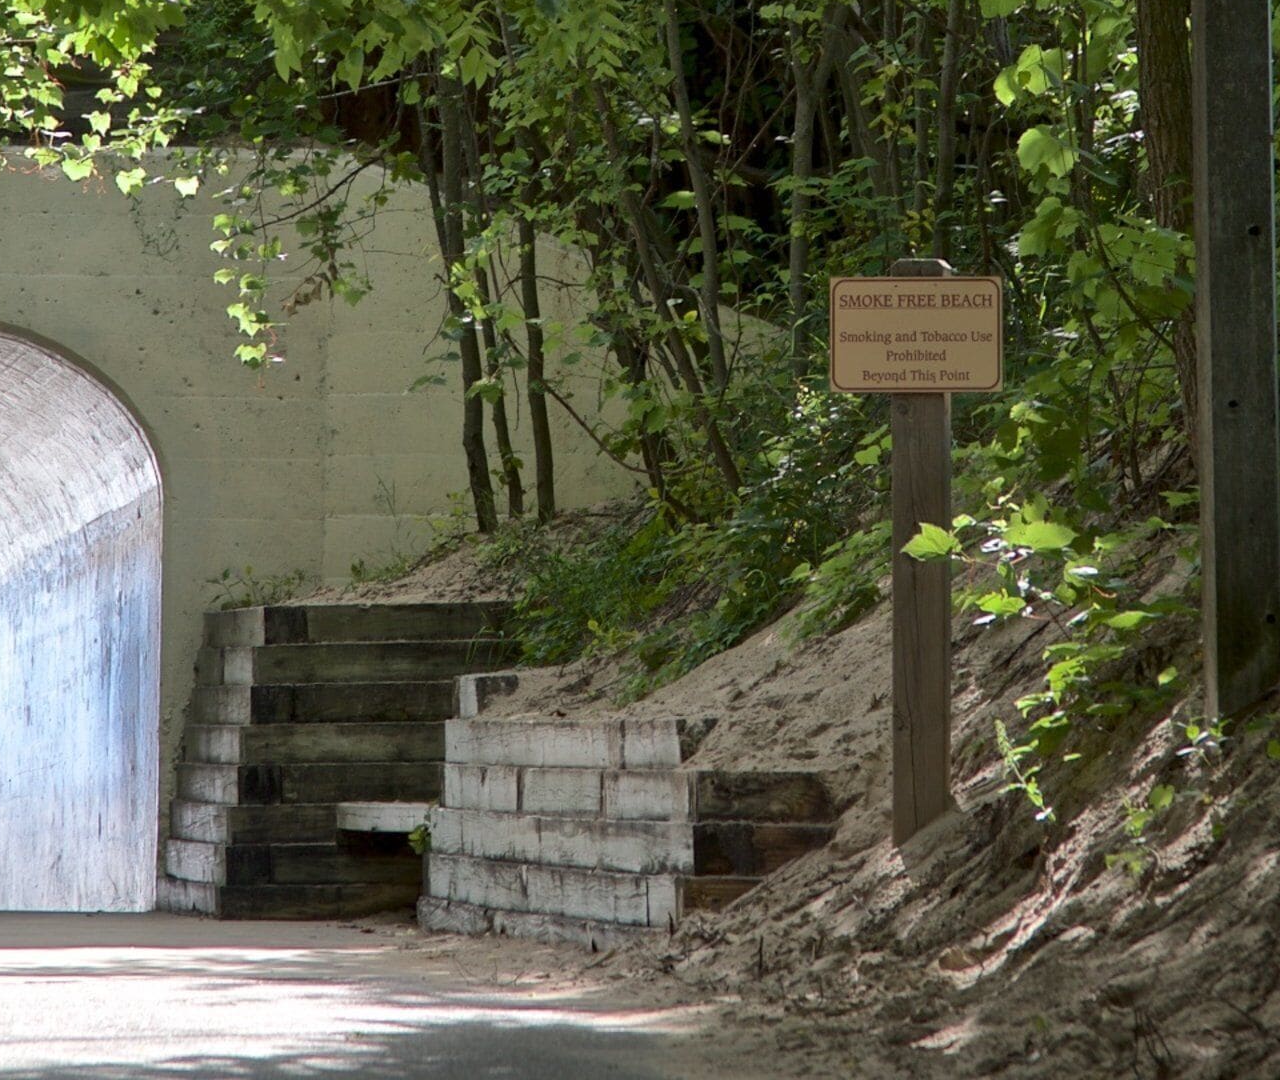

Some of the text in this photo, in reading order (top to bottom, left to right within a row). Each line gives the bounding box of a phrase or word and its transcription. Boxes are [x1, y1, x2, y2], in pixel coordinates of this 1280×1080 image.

[840, 294, 993, 308] SMOKE FREE BEACH
[840, 331, 992, 344] Smoking and Tobacco Use
[886, 350, 947, 361] Prohibited
[863, 370, 970, 383] Beyond This Point
